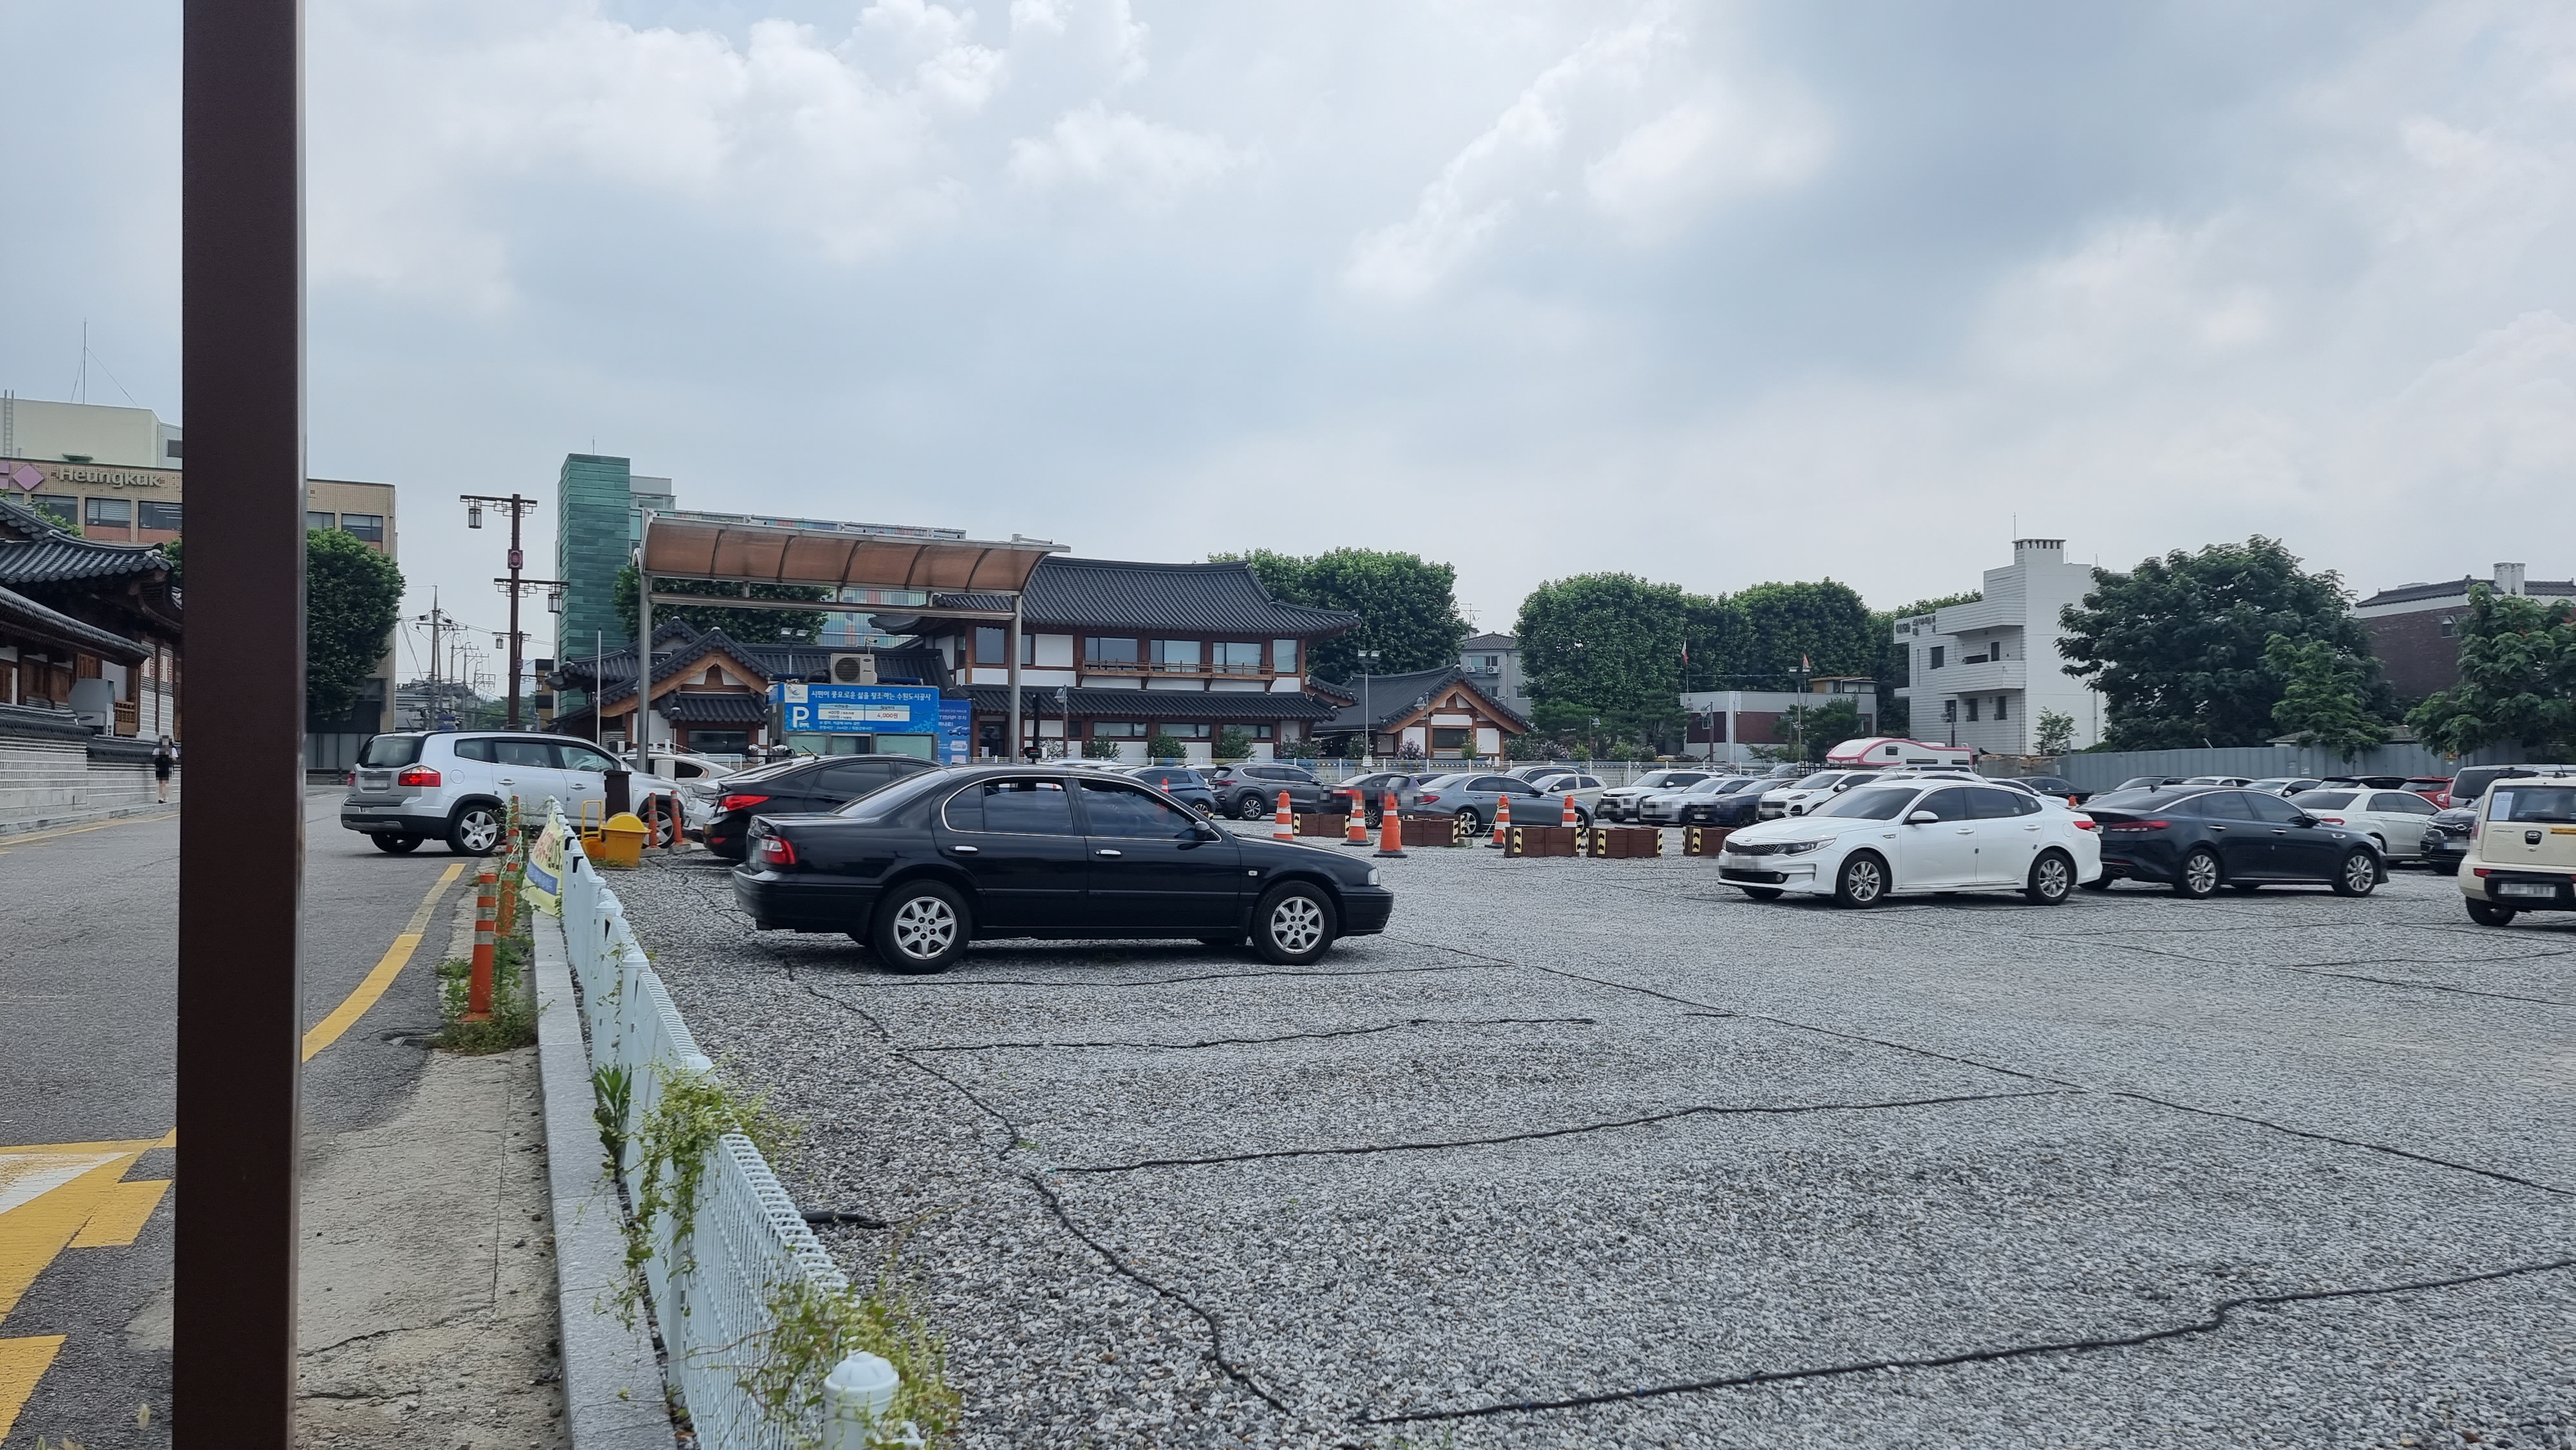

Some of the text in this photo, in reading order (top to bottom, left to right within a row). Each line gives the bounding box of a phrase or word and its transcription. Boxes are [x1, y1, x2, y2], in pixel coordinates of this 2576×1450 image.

[59, 466, 162, 489] Heungkuk
[811, 690, 931, 701] 시민이 풍요로운 삶을 창조하는 수원도시공사
[793, 706, 810, 728] P
